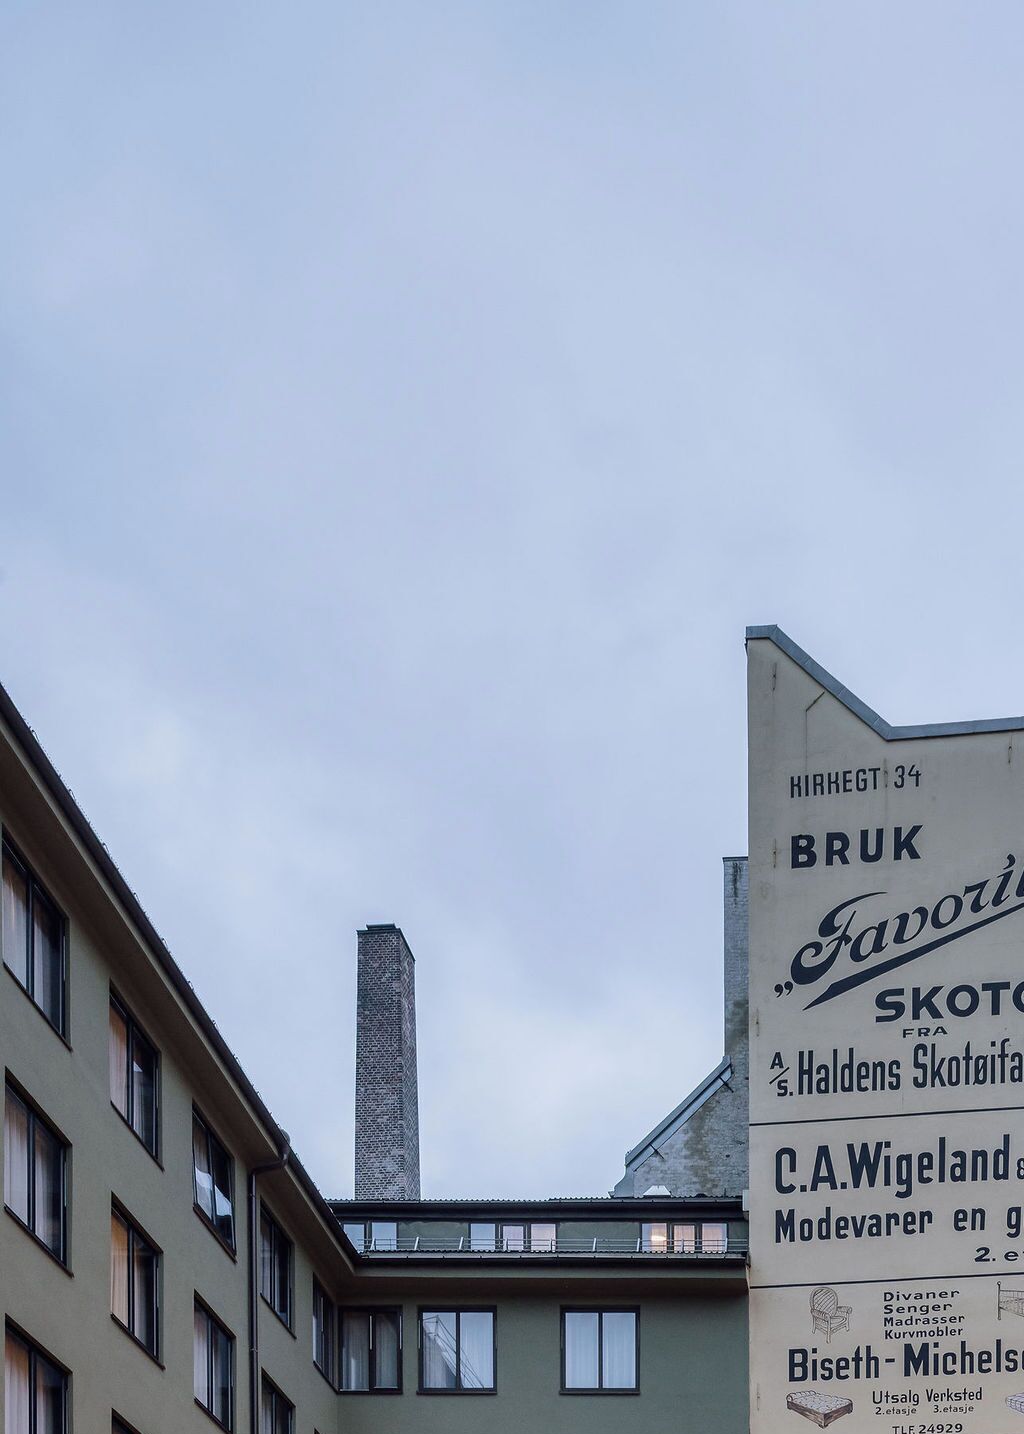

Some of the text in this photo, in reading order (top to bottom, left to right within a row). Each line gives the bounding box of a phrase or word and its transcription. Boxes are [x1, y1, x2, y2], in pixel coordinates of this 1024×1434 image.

[791, 765, 921, 798] KIRKEGT 34
[791, 825, 923, 869] BRUK
[903, 1026, 947, 1038] FRA
[798, 1048, 900, 1095] Haldens
[776, 1207, 932, 1243] Modevarer
[954, 1208, 985, 1231] en
[975, 1247, 995, 1262] 2.
[884, 1291, 959, 1302] Divaner
[884, 1304, 952, 1315] Senger
[884, 1316, 964, 1328] Madrasser
[873, 1387, 982, 1407] Utsalg Verksted
[919, 1424, 962, 1434] 24929
